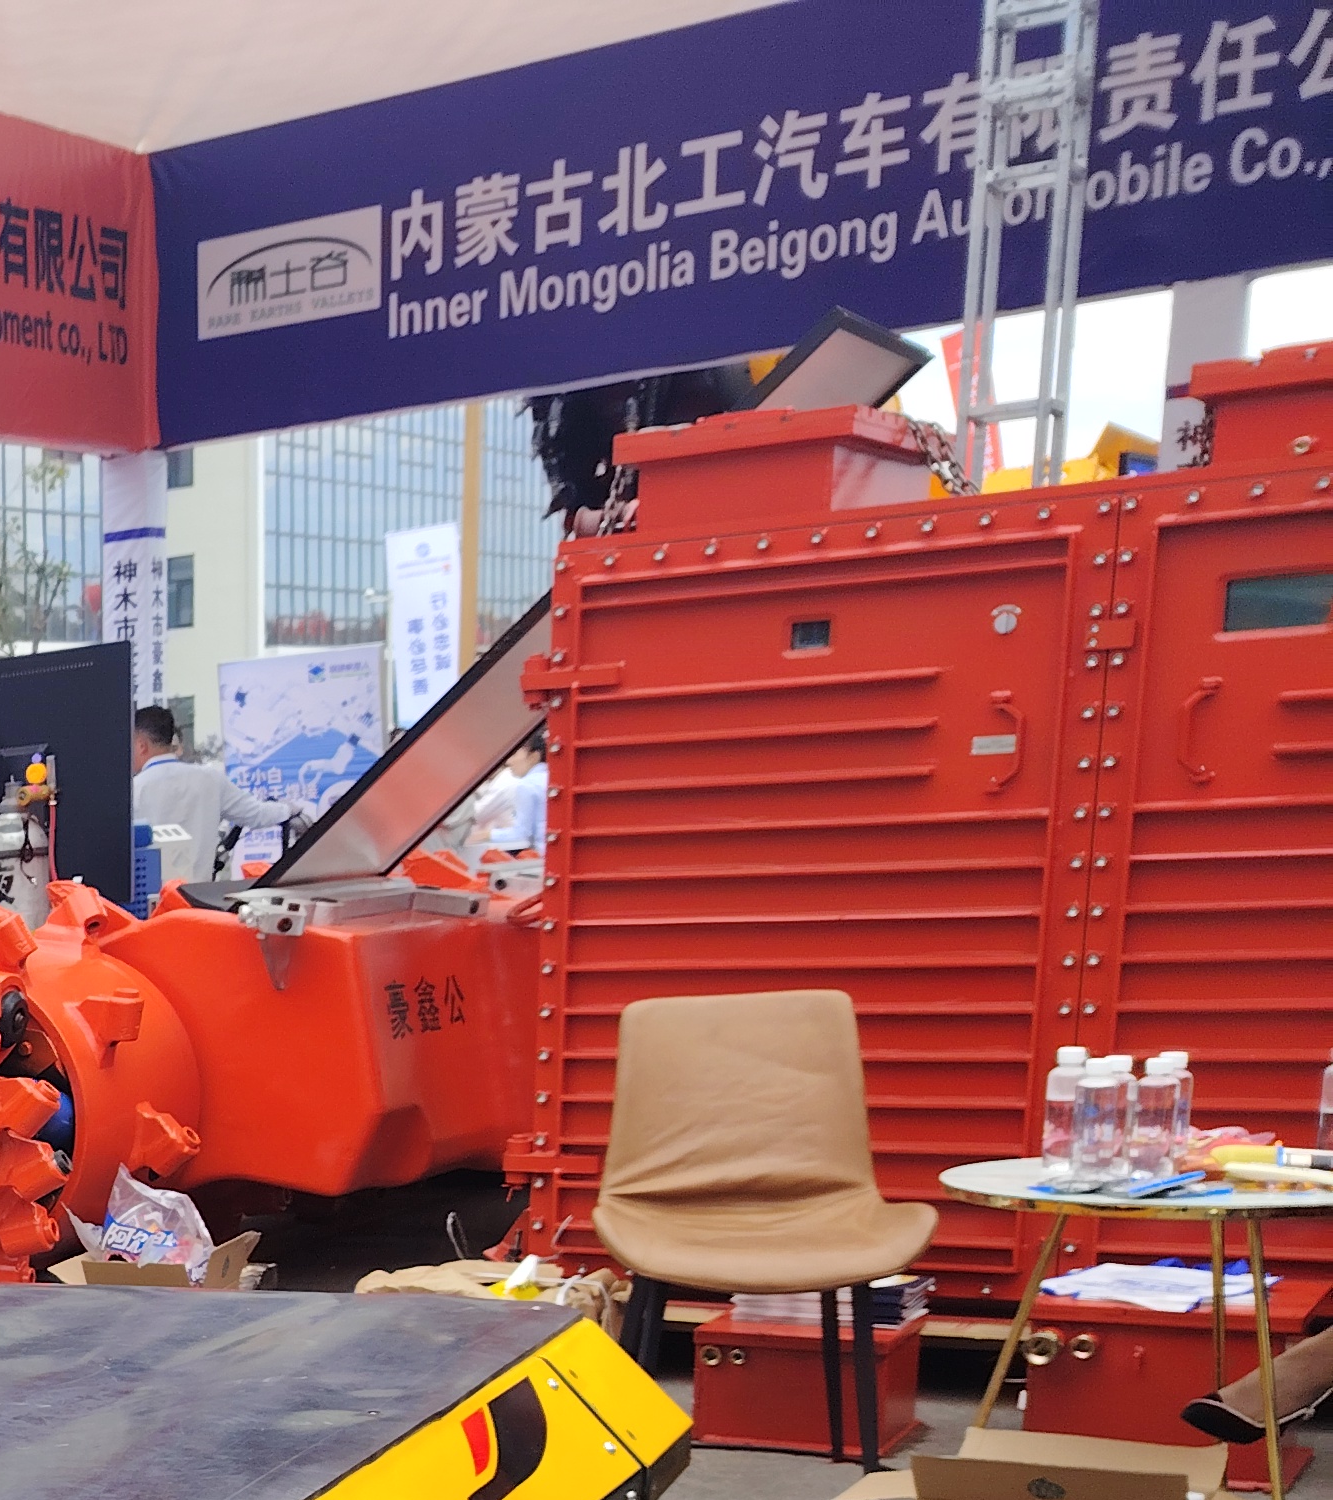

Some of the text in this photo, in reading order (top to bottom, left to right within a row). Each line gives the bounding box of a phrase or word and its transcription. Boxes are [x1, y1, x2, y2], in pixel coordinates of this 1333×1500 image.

[387, 287, 489, 340] Inner
[498, 241, 696, 321] Mongolia
[709, 210, 898, 283] Beigong
[911, 143, 1212, 245] Auoobile
[250, 301, 303, 323] EARTHS
[312, 287, 376, 310] VALLEYS
[98, 321, 129, 366] LTD
